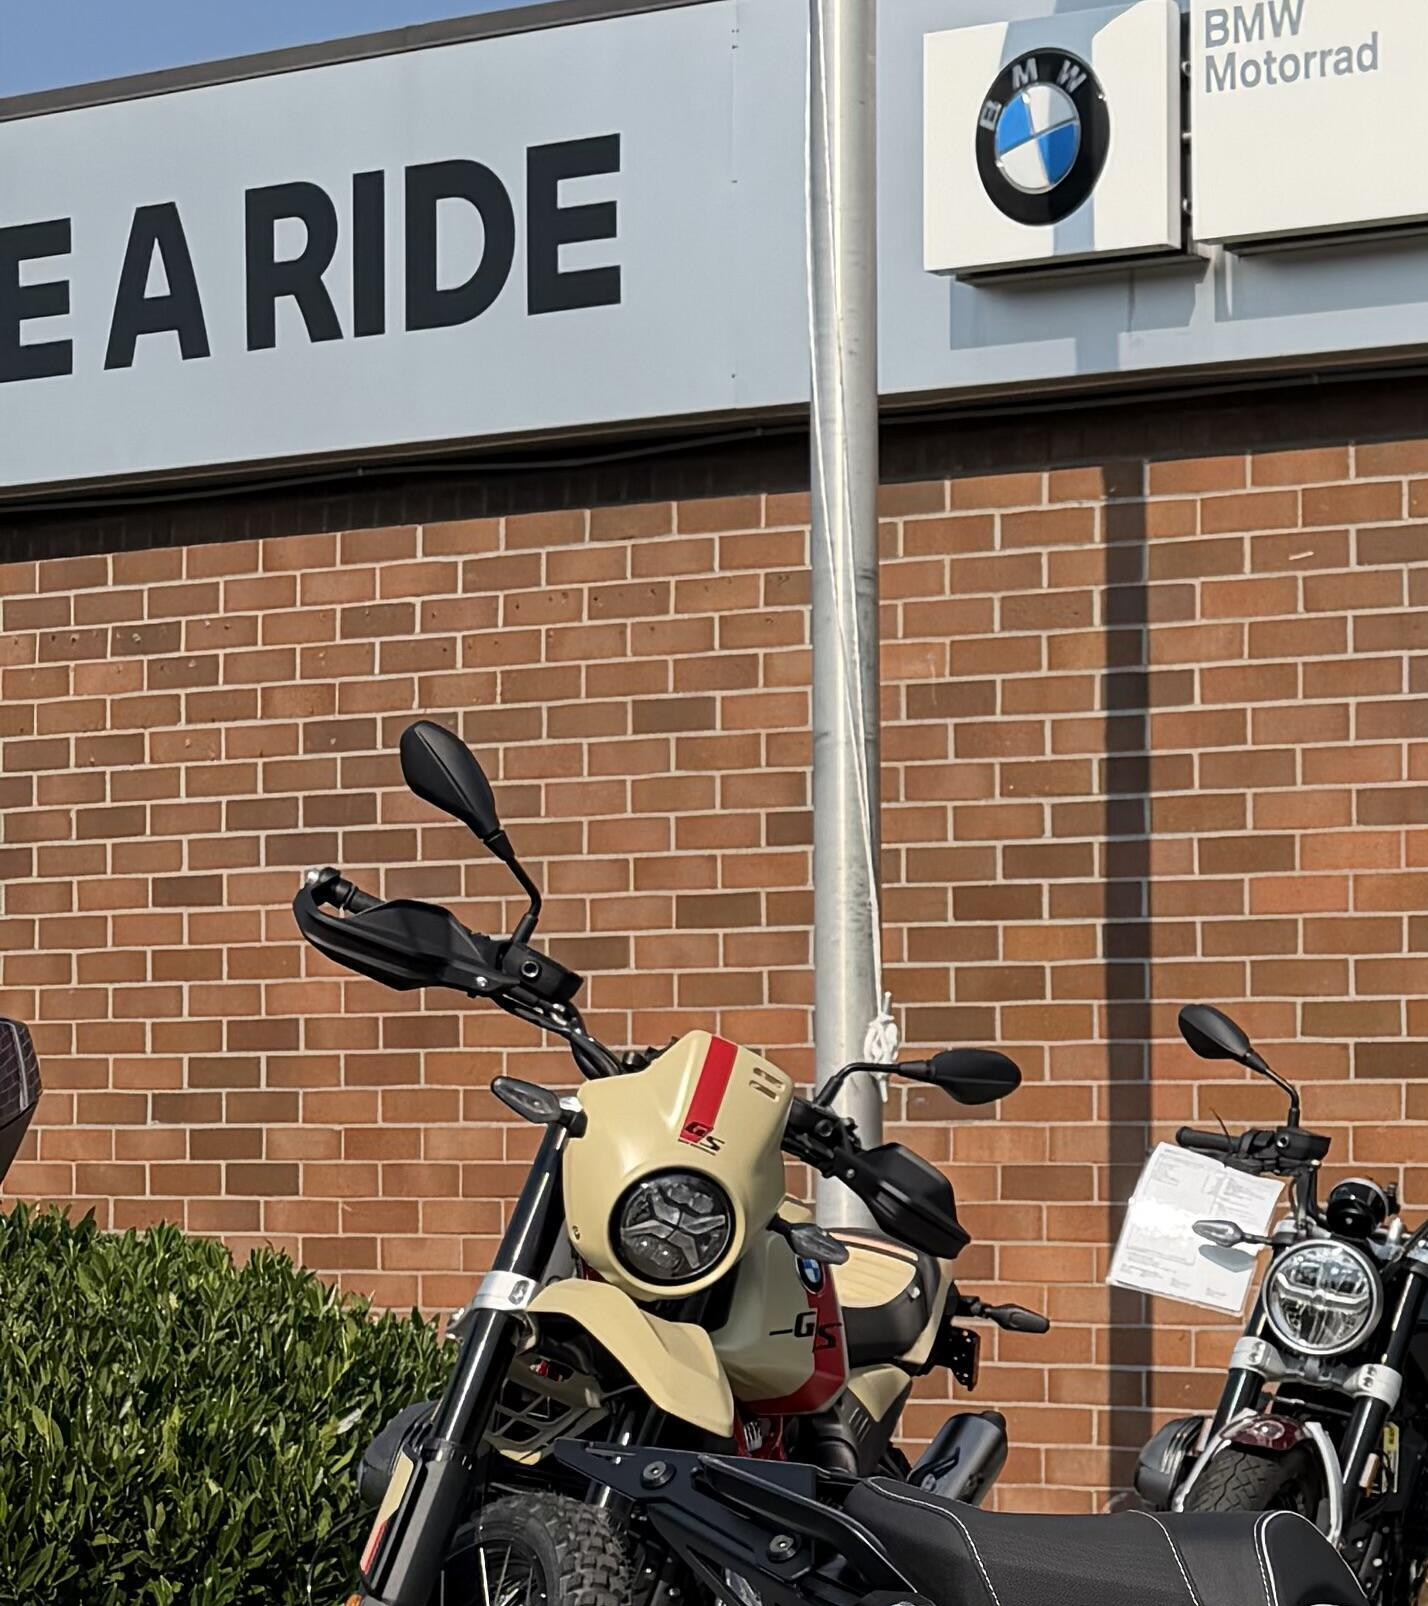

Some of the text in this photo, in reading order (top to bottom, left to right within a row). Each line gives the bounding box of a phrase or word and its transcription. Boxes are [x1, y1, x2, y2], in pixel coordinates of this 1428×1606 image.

[1204, 0, 1304, 48] BMW
[1204, 31, 1380, 93] Motorrad
[104, 201, 211, 370] A
[245, 132, 621, 352] RIDE
[793, 1311, 843, 1350] GS
